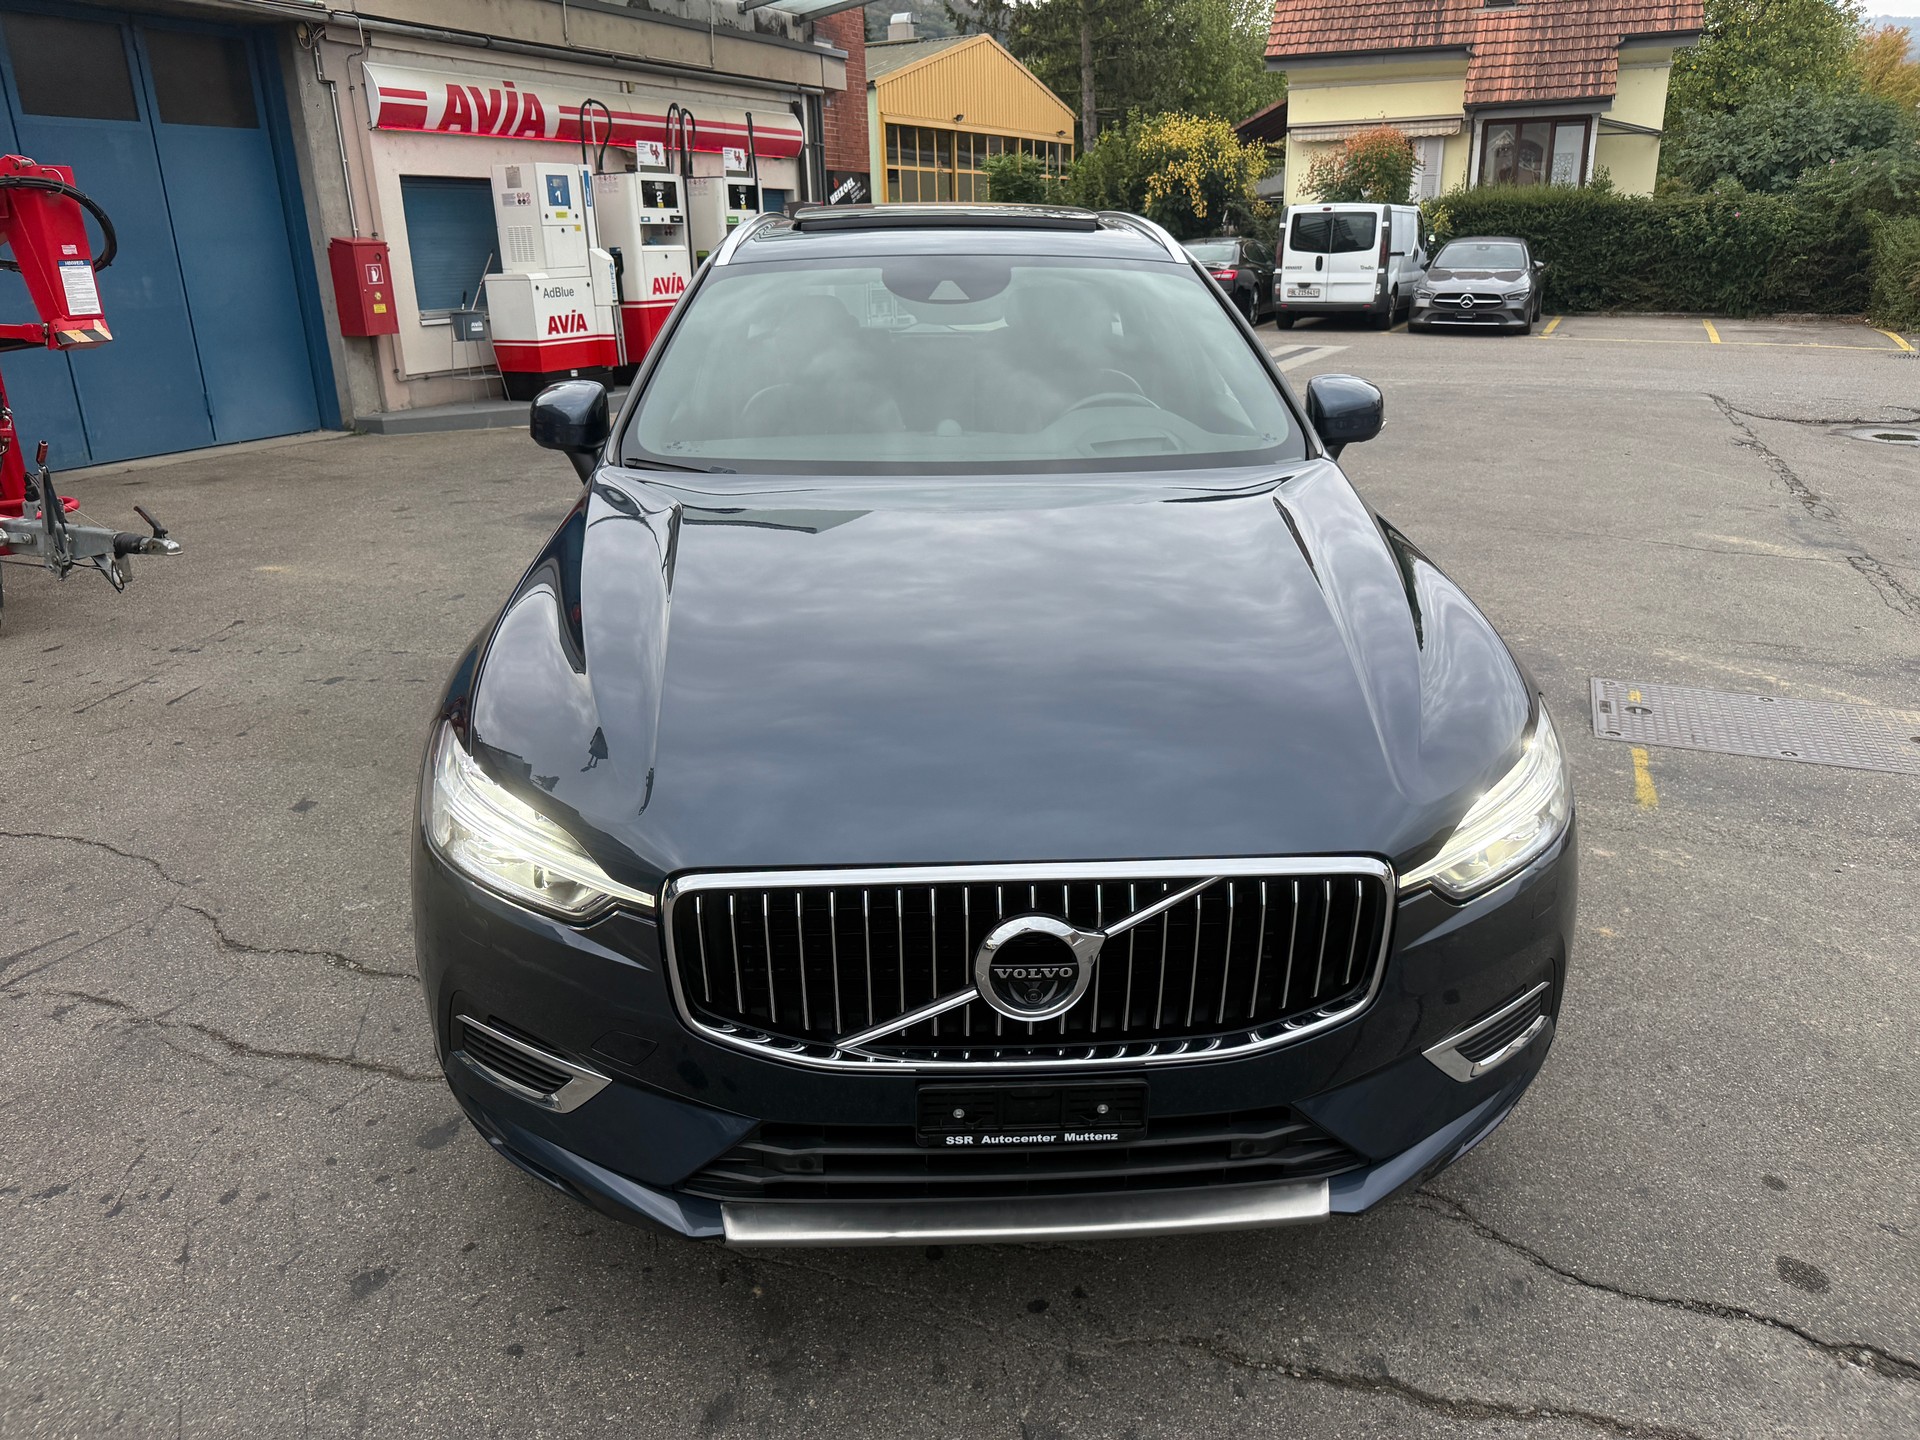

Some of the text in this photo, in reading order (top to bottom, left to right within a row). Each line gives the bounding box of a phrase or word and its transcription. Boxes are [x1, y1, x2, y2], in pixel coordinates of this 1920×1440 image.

[437, 80, 546, 137] AVIA
[554, 190, 562, 203] 1
[656, 191, 664, 203] 2
[829, 177, 856, 205] HEIZOEL
[740, 194, 746, 204] 3
[652, 272, 685, 295] AVIA
[543, 286, 575, 299] AdBlue
[547, 309, 589, 336] AVIA
[993, 967, 1074, 979] VOLVO
[945, 1132, 1119, 1145] SSR Autocenter Muttenz
